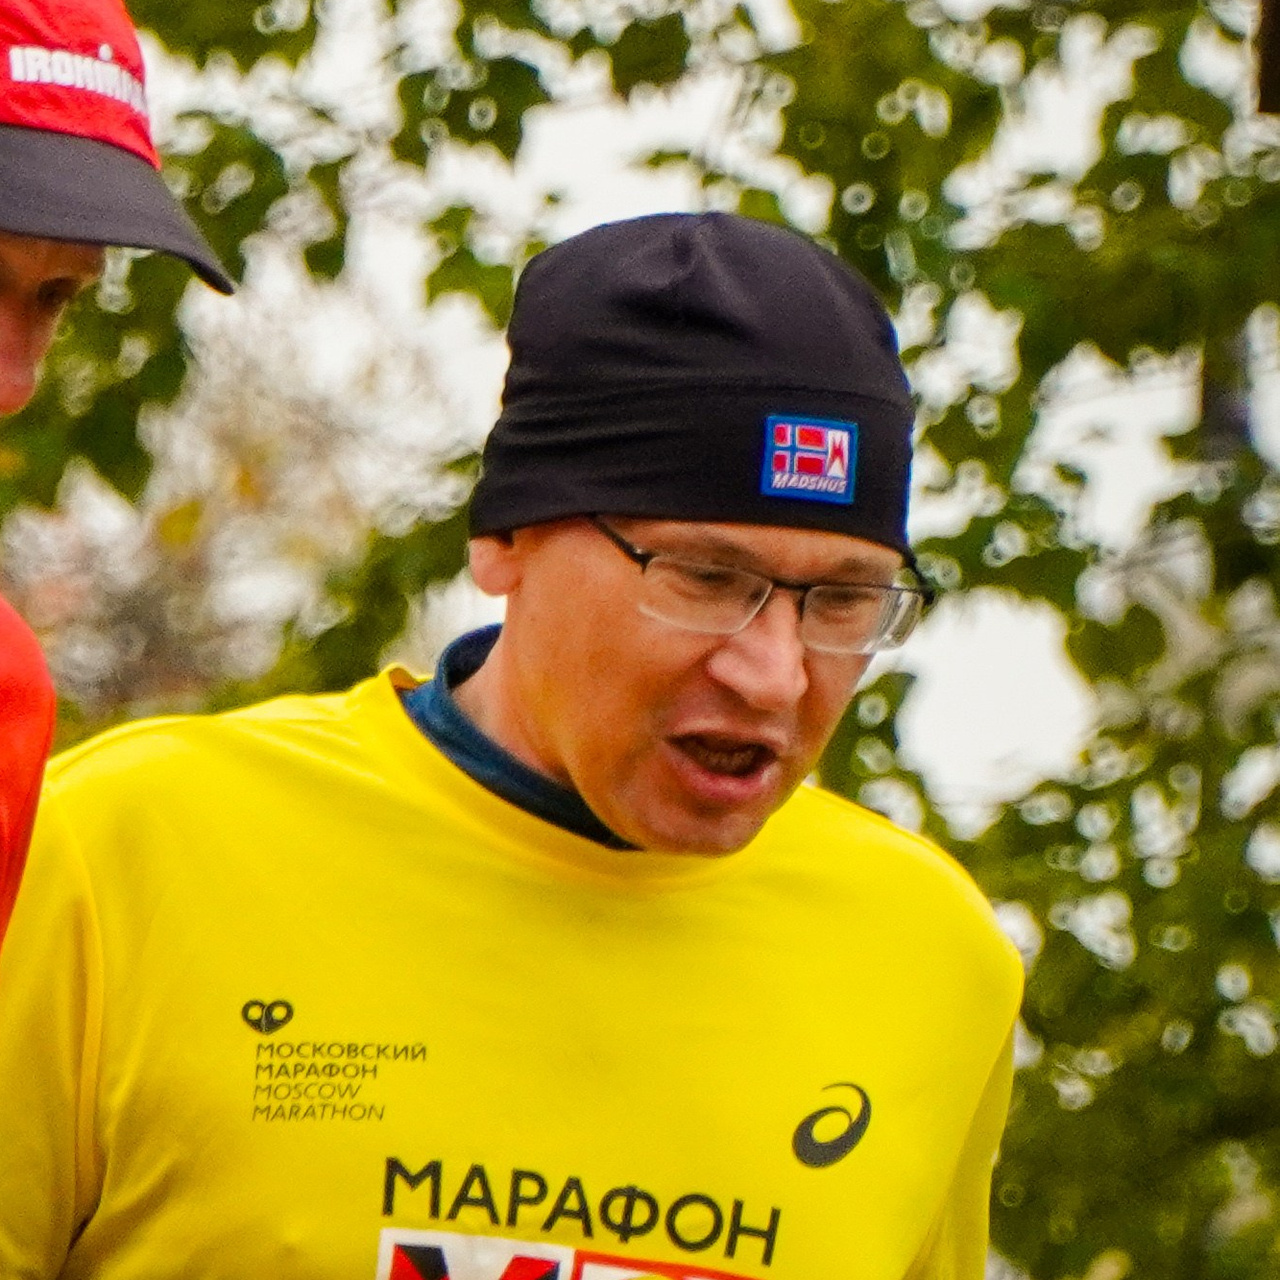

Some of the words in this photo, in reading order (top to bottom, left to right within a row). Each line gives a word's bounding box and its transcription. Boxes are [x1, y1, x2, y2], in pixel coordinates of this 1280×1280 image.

[772, 472, 847, 494] MADSHUS
[256, 1042, 427, 1061] МОСКОВСКИЙ
[255, 1062, 378, 1080] МАРАФОН
[253, 1083, 362, 1101] MOSCOW
[251, 1102, 386, 1122] MARATHON
[381, 1156, 782, 1267] МАРАФОН
